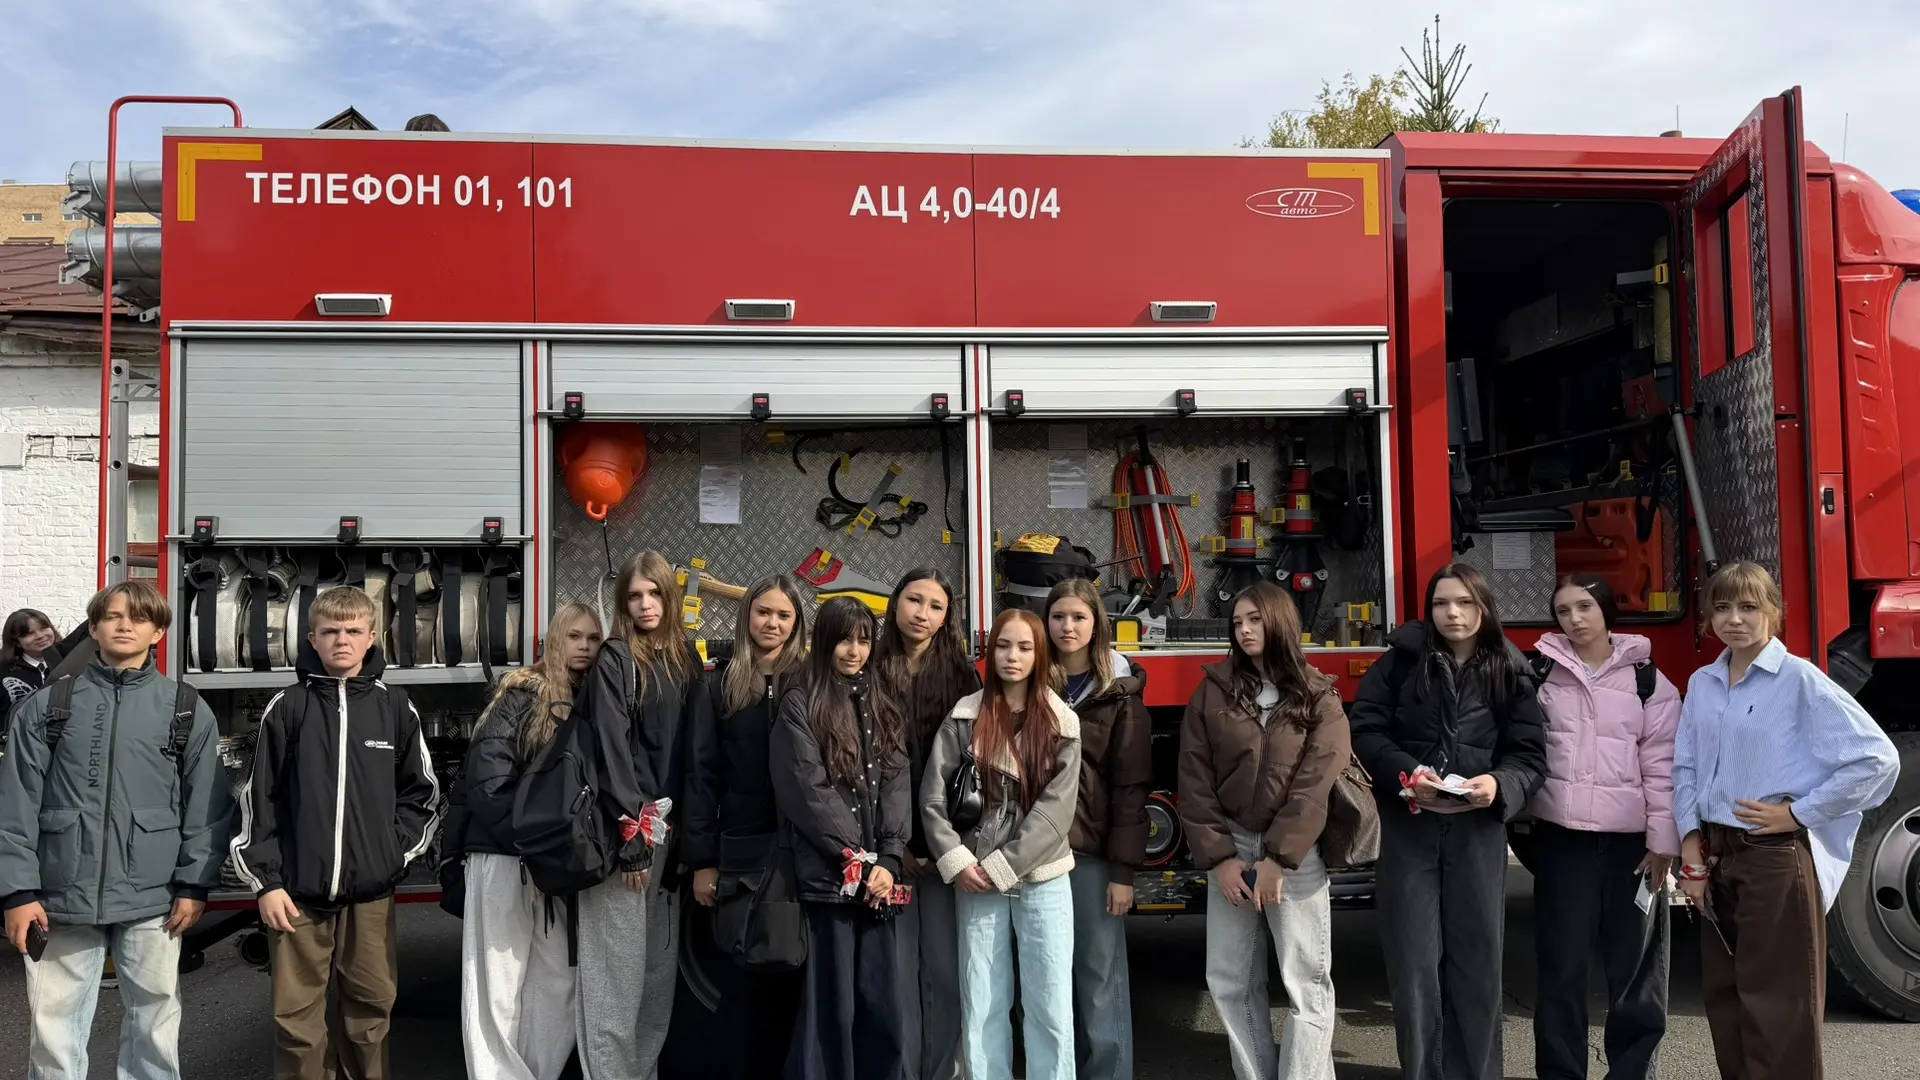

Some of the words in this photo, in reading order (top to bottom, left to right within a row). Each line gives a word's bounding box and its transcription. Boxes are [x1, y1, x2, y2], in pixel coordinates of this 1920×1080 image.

[245, 172, 440, 206] ТЕЛЕФОН
[454, 174, 503, 212] 01,
[517, 176, 572, 208] 101
[849, 184, 908, 224] АЦ
[919, 186, 1061, 224] 4,0-40/4
[1280, 207, 1318, 216] авто
[87, 703, 108, 788] NORTHLAND
